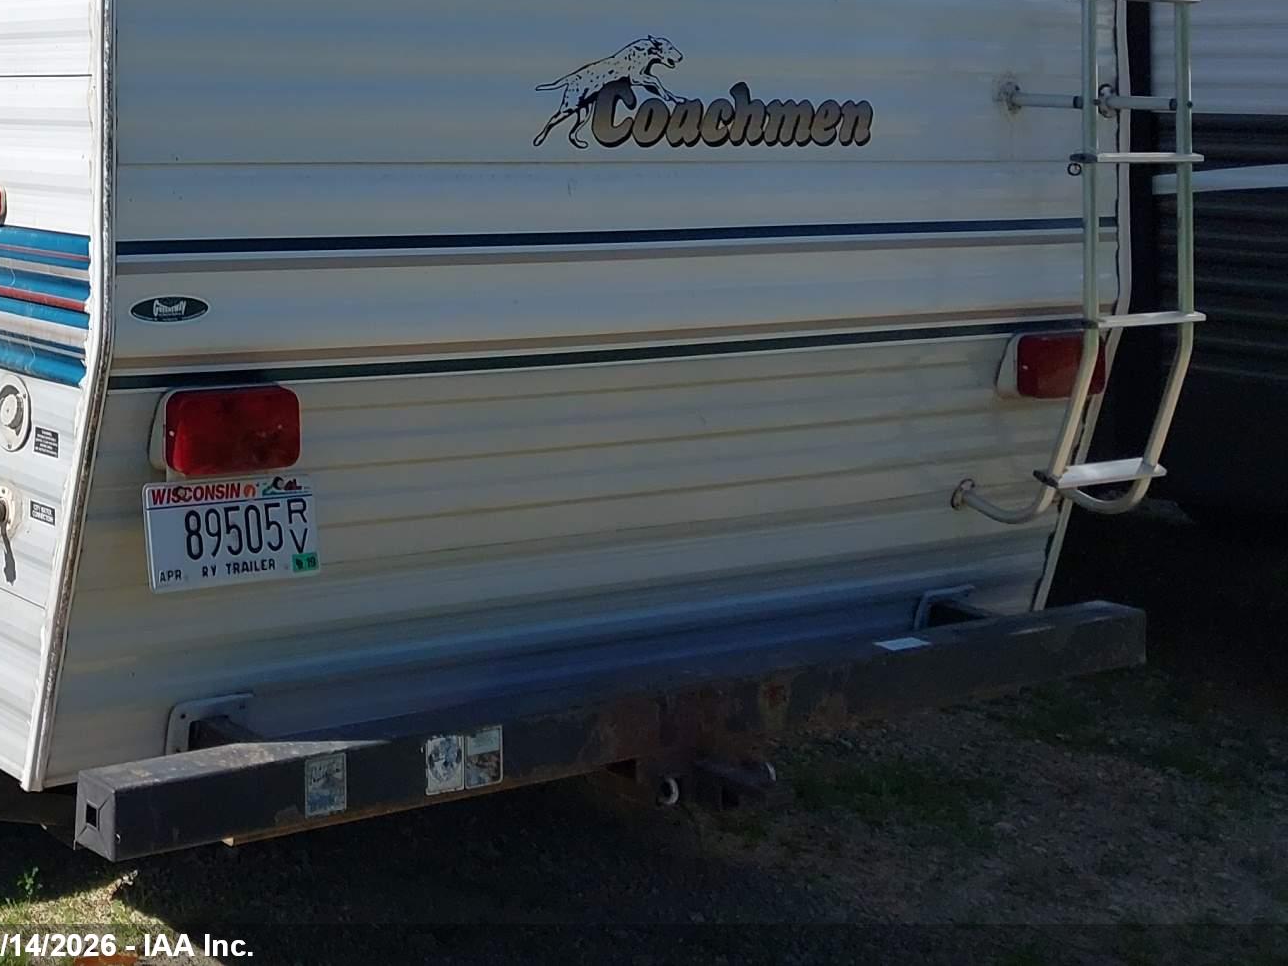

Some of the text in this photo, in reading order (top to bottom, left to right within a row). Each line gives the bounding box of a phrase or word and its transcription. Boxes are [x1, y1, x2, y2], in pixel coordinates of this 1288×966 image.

[591, 77, 874, 148] Coachmen
[151, 482, 241, 506] WISCONSIN
[184, 502, 284, 561] 89505
[159, 569, 182, 583] APR
[225, 558, 276, 575] TRAILER
